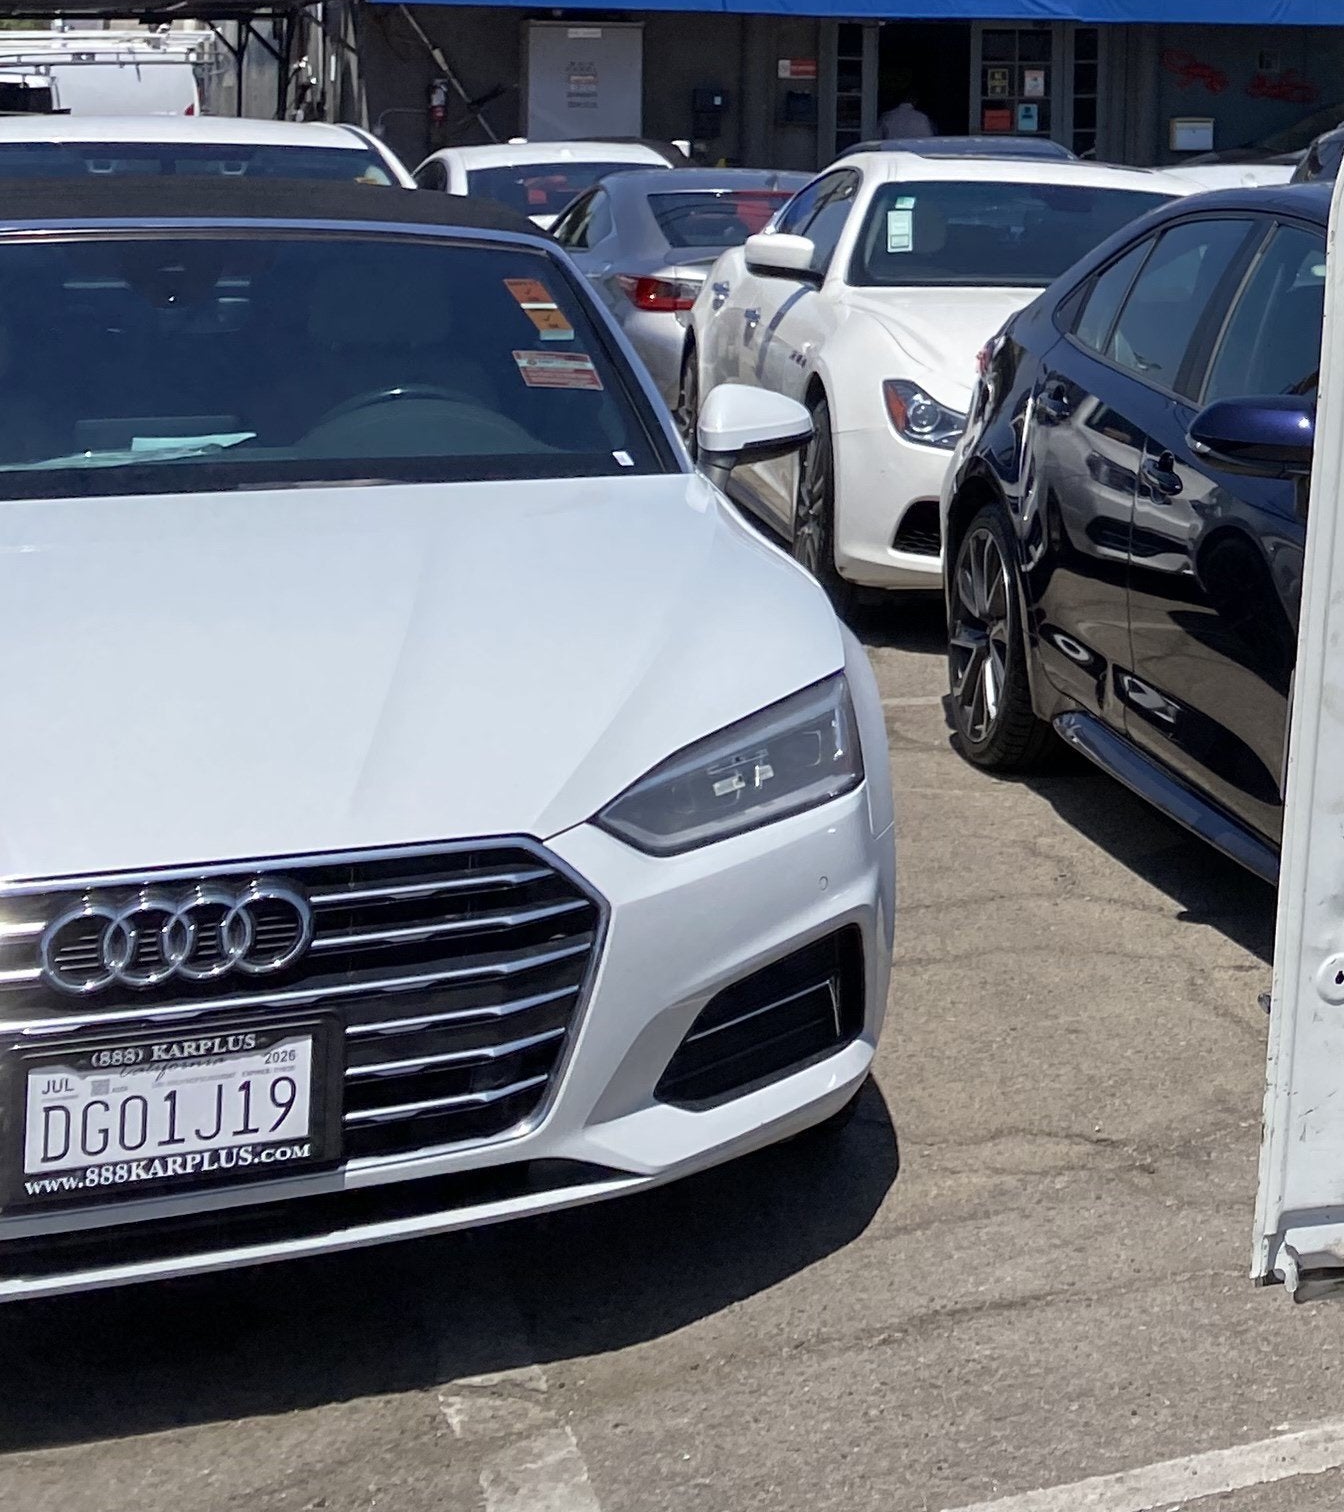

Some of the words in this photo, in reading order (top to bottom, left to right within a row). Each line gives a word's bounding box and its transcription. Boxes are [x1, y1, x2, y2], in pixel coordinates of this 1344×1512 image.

[91, 1050, 144, 1068] (888)
[152, 1034, 257, 1061] KARPLUS
[42, 1079, 75, 1095] JUL
[41, 1076, 297, 1163] DG01J19
